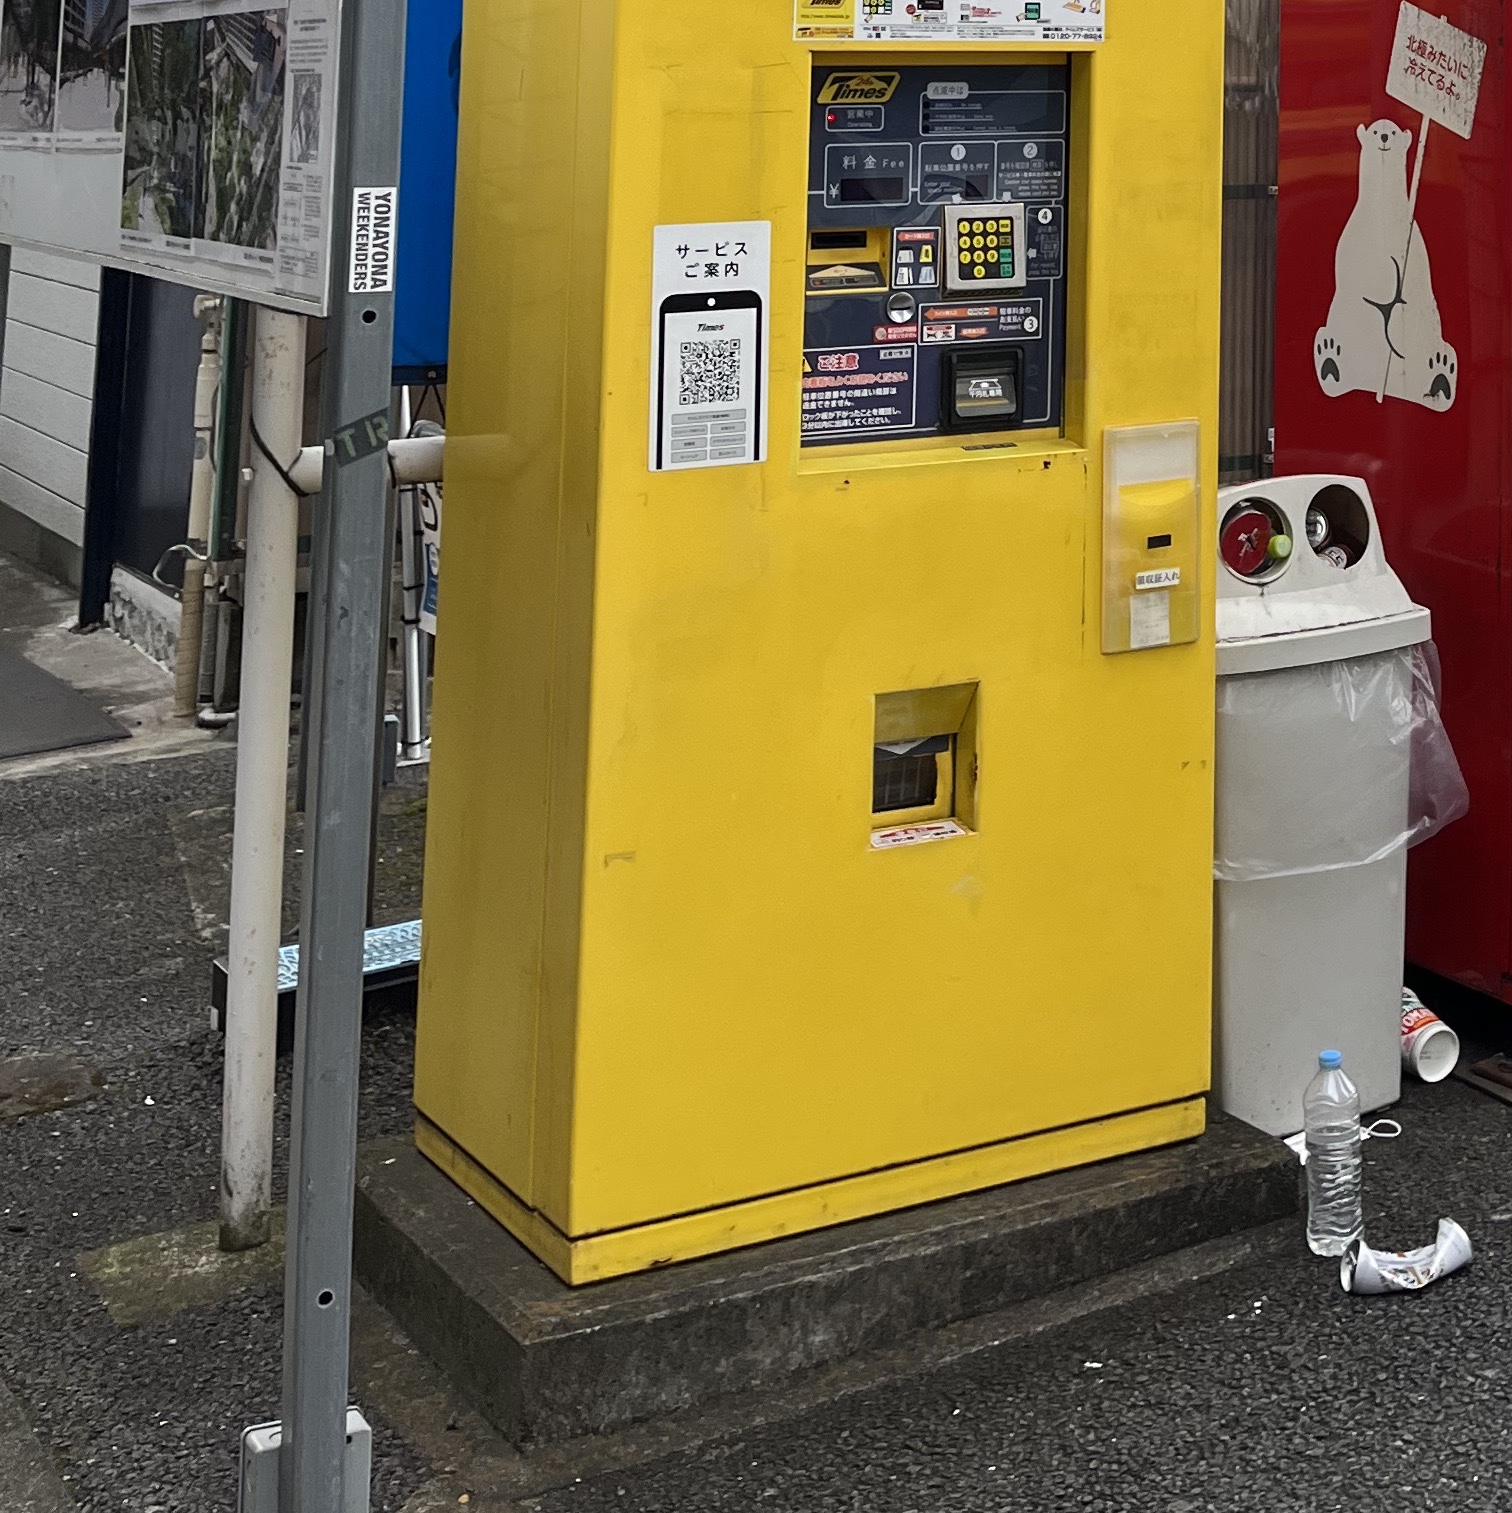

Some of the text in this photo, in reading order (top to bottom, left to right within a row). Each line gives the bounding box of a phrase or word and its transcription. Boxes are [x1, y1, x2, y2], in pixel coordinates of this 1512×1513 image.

[1403, 56, 1461, 100] 冷えてるよ。
[1406, 34, 1469, 80] 北極みたいに
[831, 83, 889, 101] Times
[353, 191, 372, 291] WEEKENDERS
[370, 191, 392, 290] YONAYONA
[676, 241, 748, 259] サービス
[684, 261, 740, 278] ご案内
